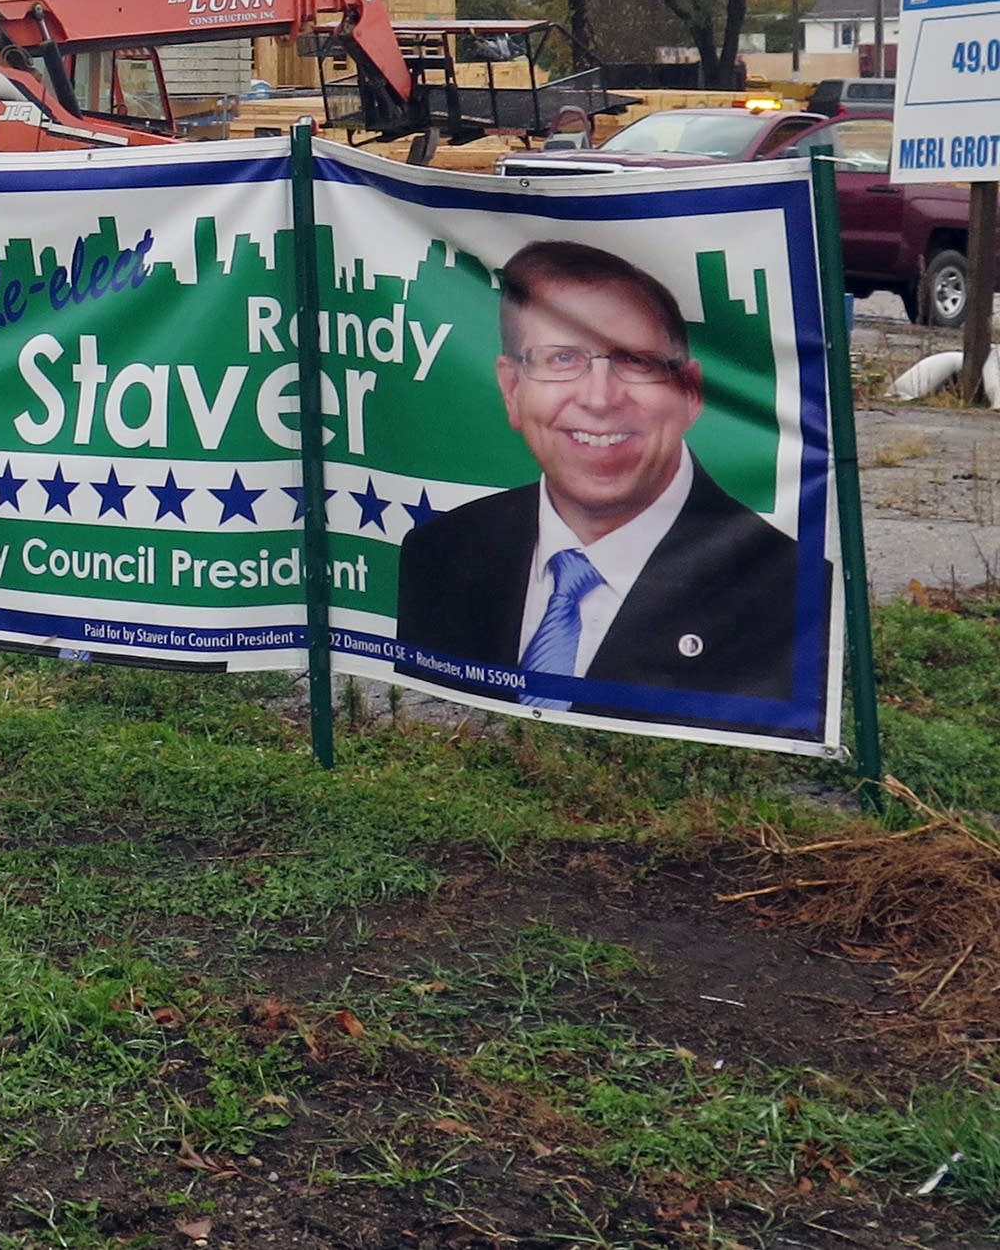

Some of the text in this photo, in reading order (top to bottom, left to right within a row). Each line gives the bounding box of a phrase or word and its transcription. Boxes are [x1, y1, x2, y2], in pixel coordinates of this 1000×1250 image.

[189, 14, 257, 26] CONSTRUCTION
[899, 137, 945, 170] MERL
[13, 333, 377, 456] Staver
[22, 539, 155, 586] Council
[171, 548, 369, 593] Presidnt
[85, 623, 105, 639] Paid
[107, 626, 121, 640] for
[123, 628, 135, 644] by
[137, 628, 168, 645] Staver
[170, 631, 187, 646] for
[188, 632, 233, 648] Council
[236, 631, 294, 646] President
[344, 634, 381, 655] Damon
[395, 645, 406, 661] SE
[416, 651, 463, 680] Rochester,
[465, 664, 485, 682] MN
[487, 669, 526, 690] 55904
